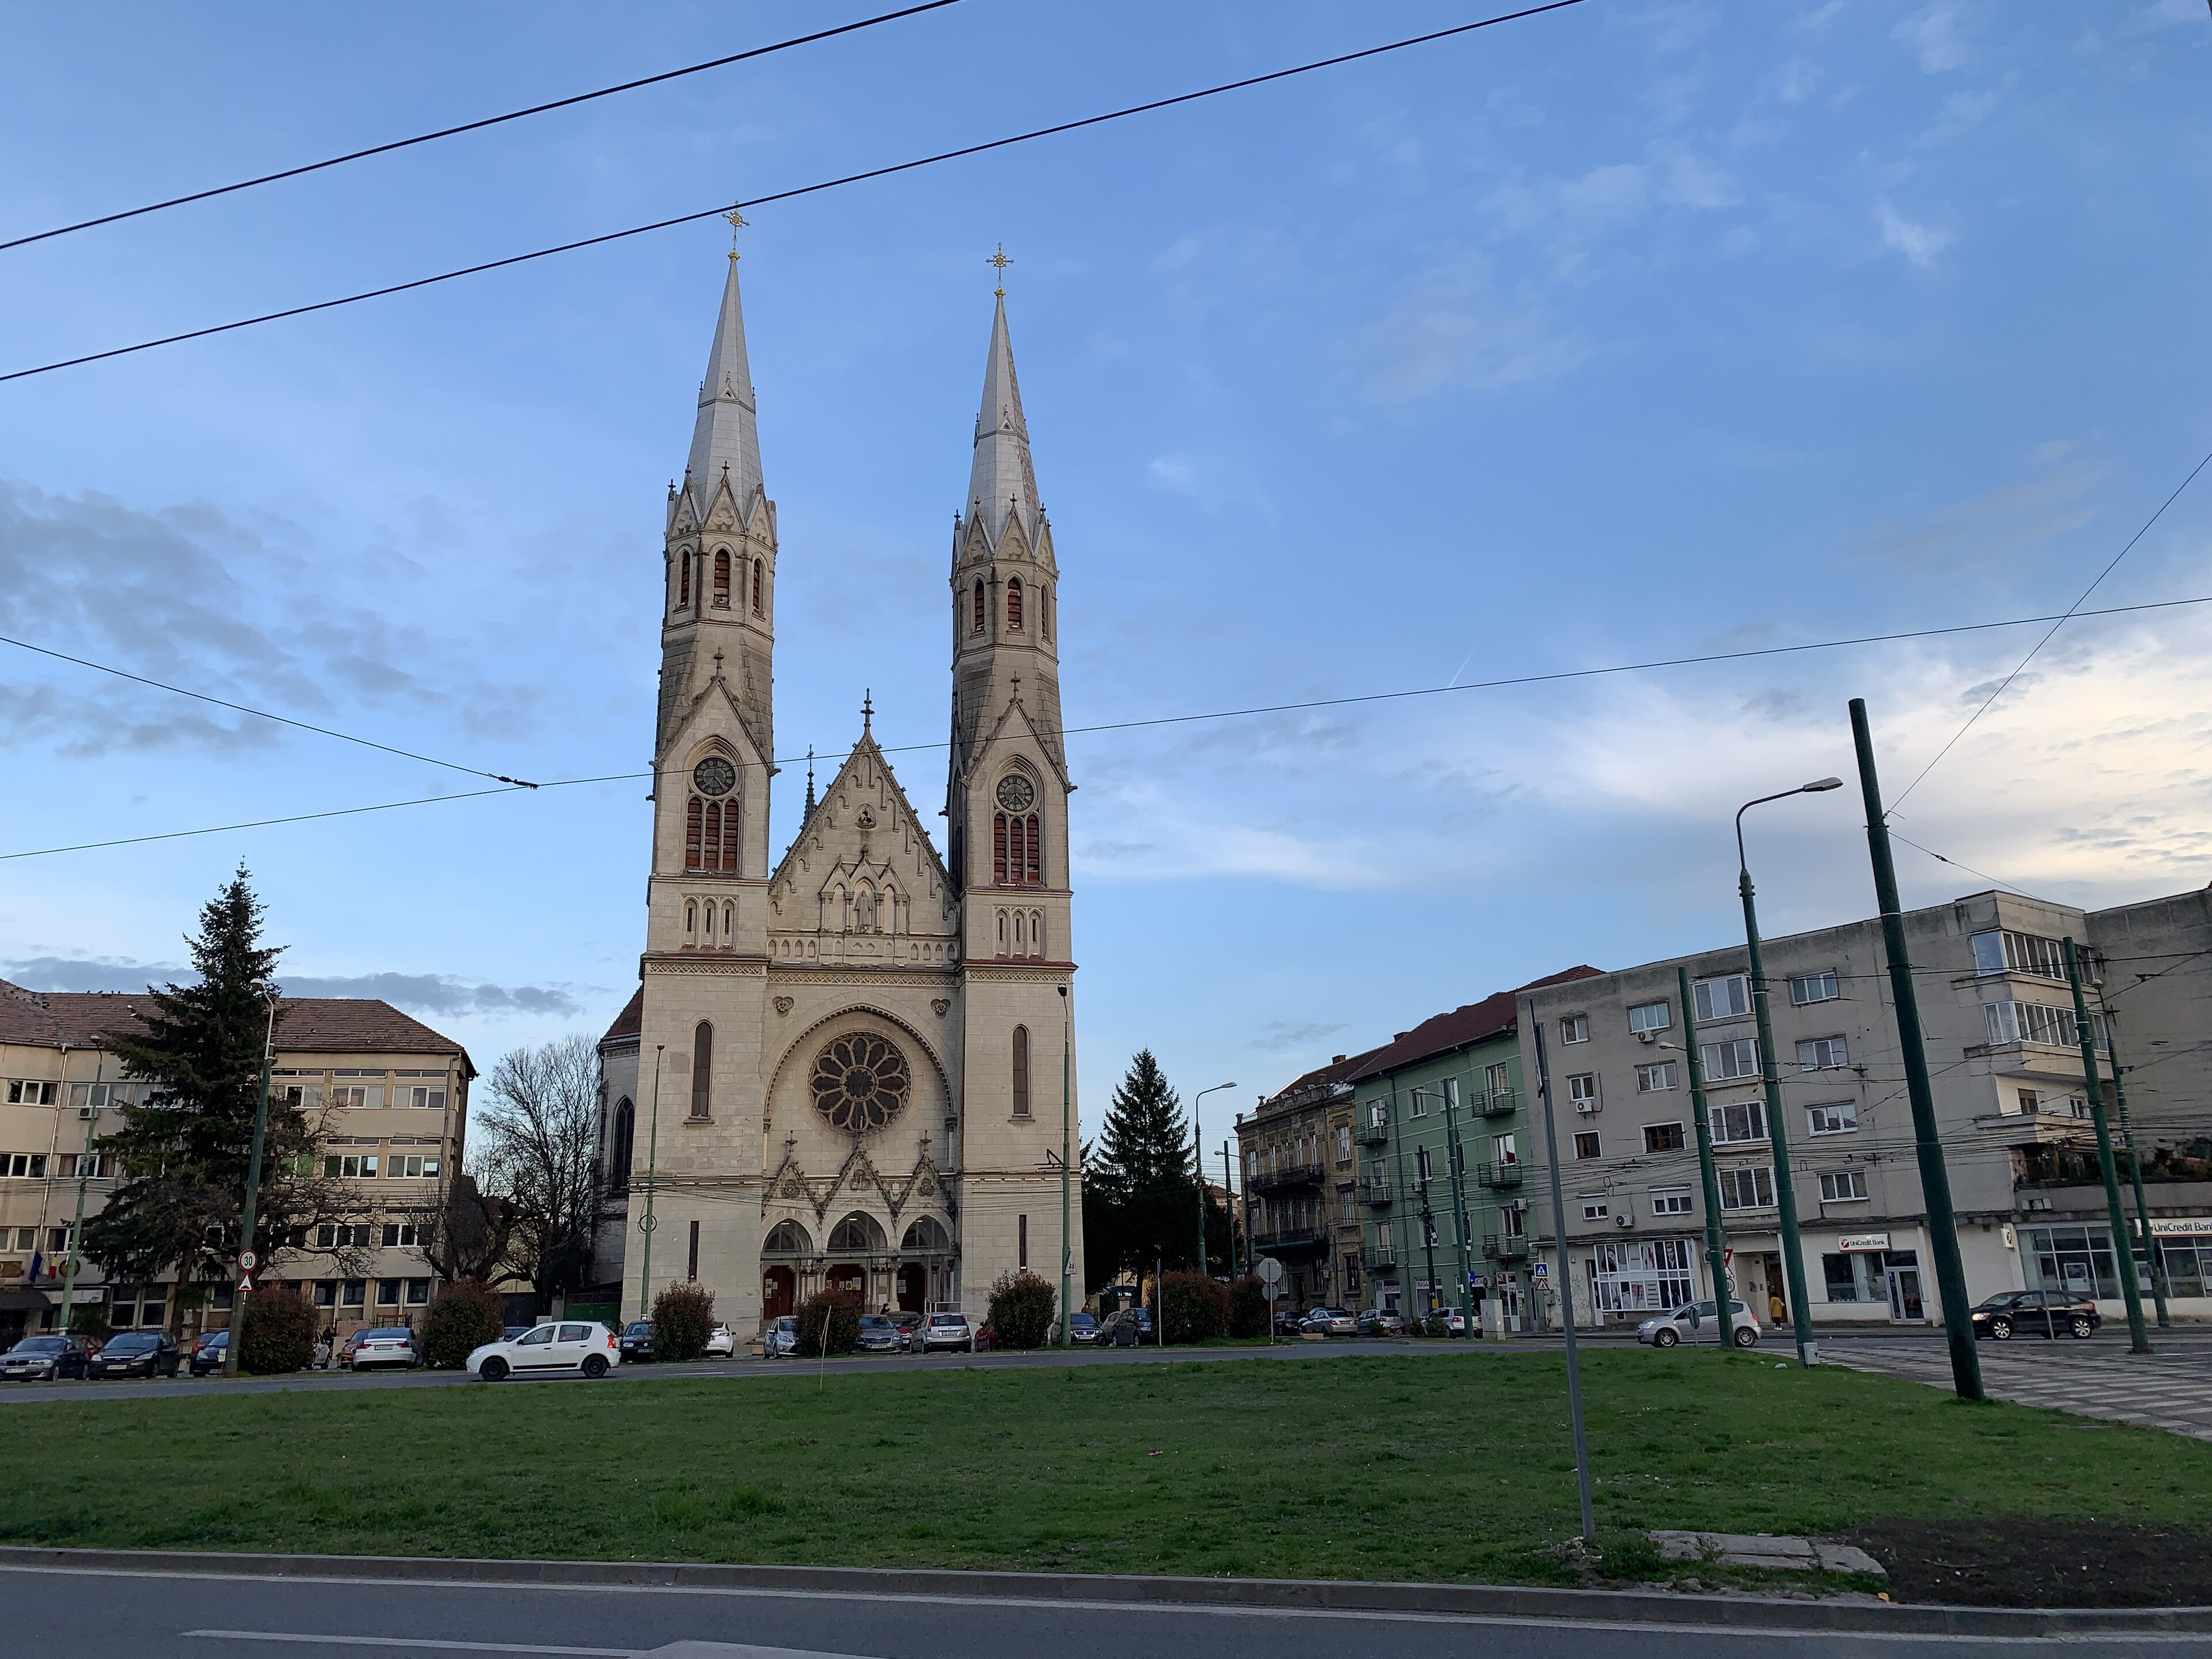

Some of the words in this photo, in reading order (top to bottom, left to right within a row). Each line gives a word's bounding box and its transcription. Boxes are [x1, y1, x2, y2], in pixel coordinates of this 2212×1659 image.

[2154, 1222, 2193, 1232] UniCredit
[2194, 1222, 2212, 1232] Ban
[244, 1256, 253, 1266] 30
